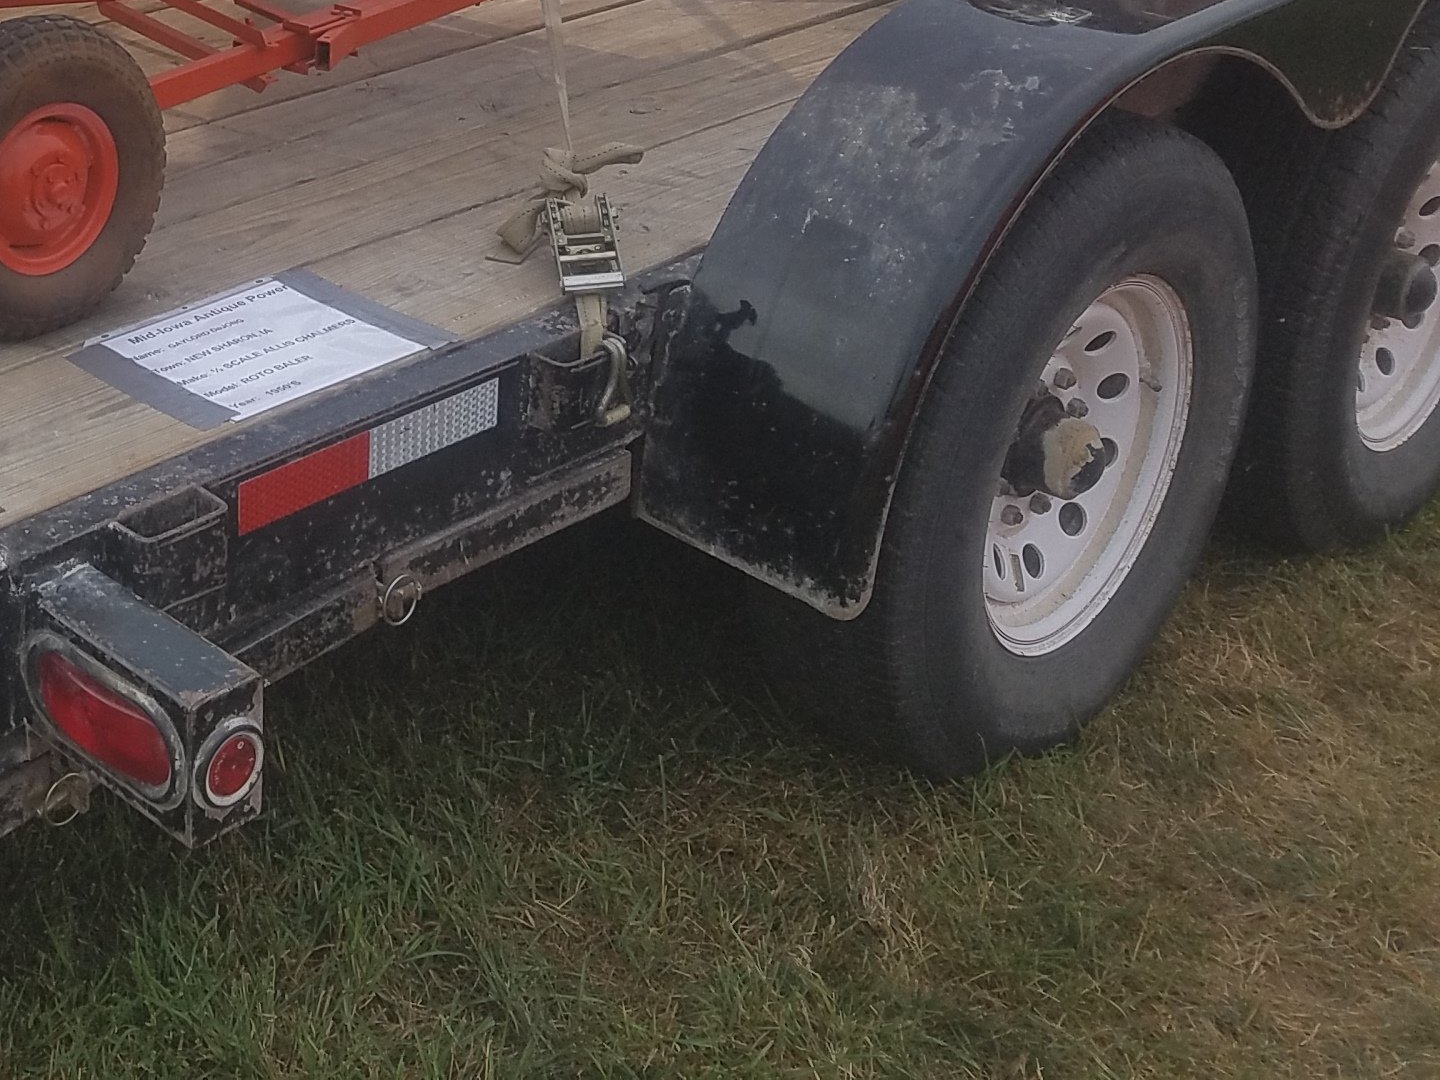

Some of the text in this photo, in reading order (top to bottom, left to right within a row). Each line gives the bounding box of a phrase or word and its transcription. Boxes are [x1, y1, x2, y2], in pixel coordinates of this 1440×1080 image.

[127, 284, 289, 345] Mid-Iowa Antique Power
[183, 349, 213, 364] NEW
[222, 350, 264, 369] SCALE
[262, 340, 296, 354] ALLIS
[239, 368, 275, 384] ROTO
[272, 354, 314, 371] BALER
